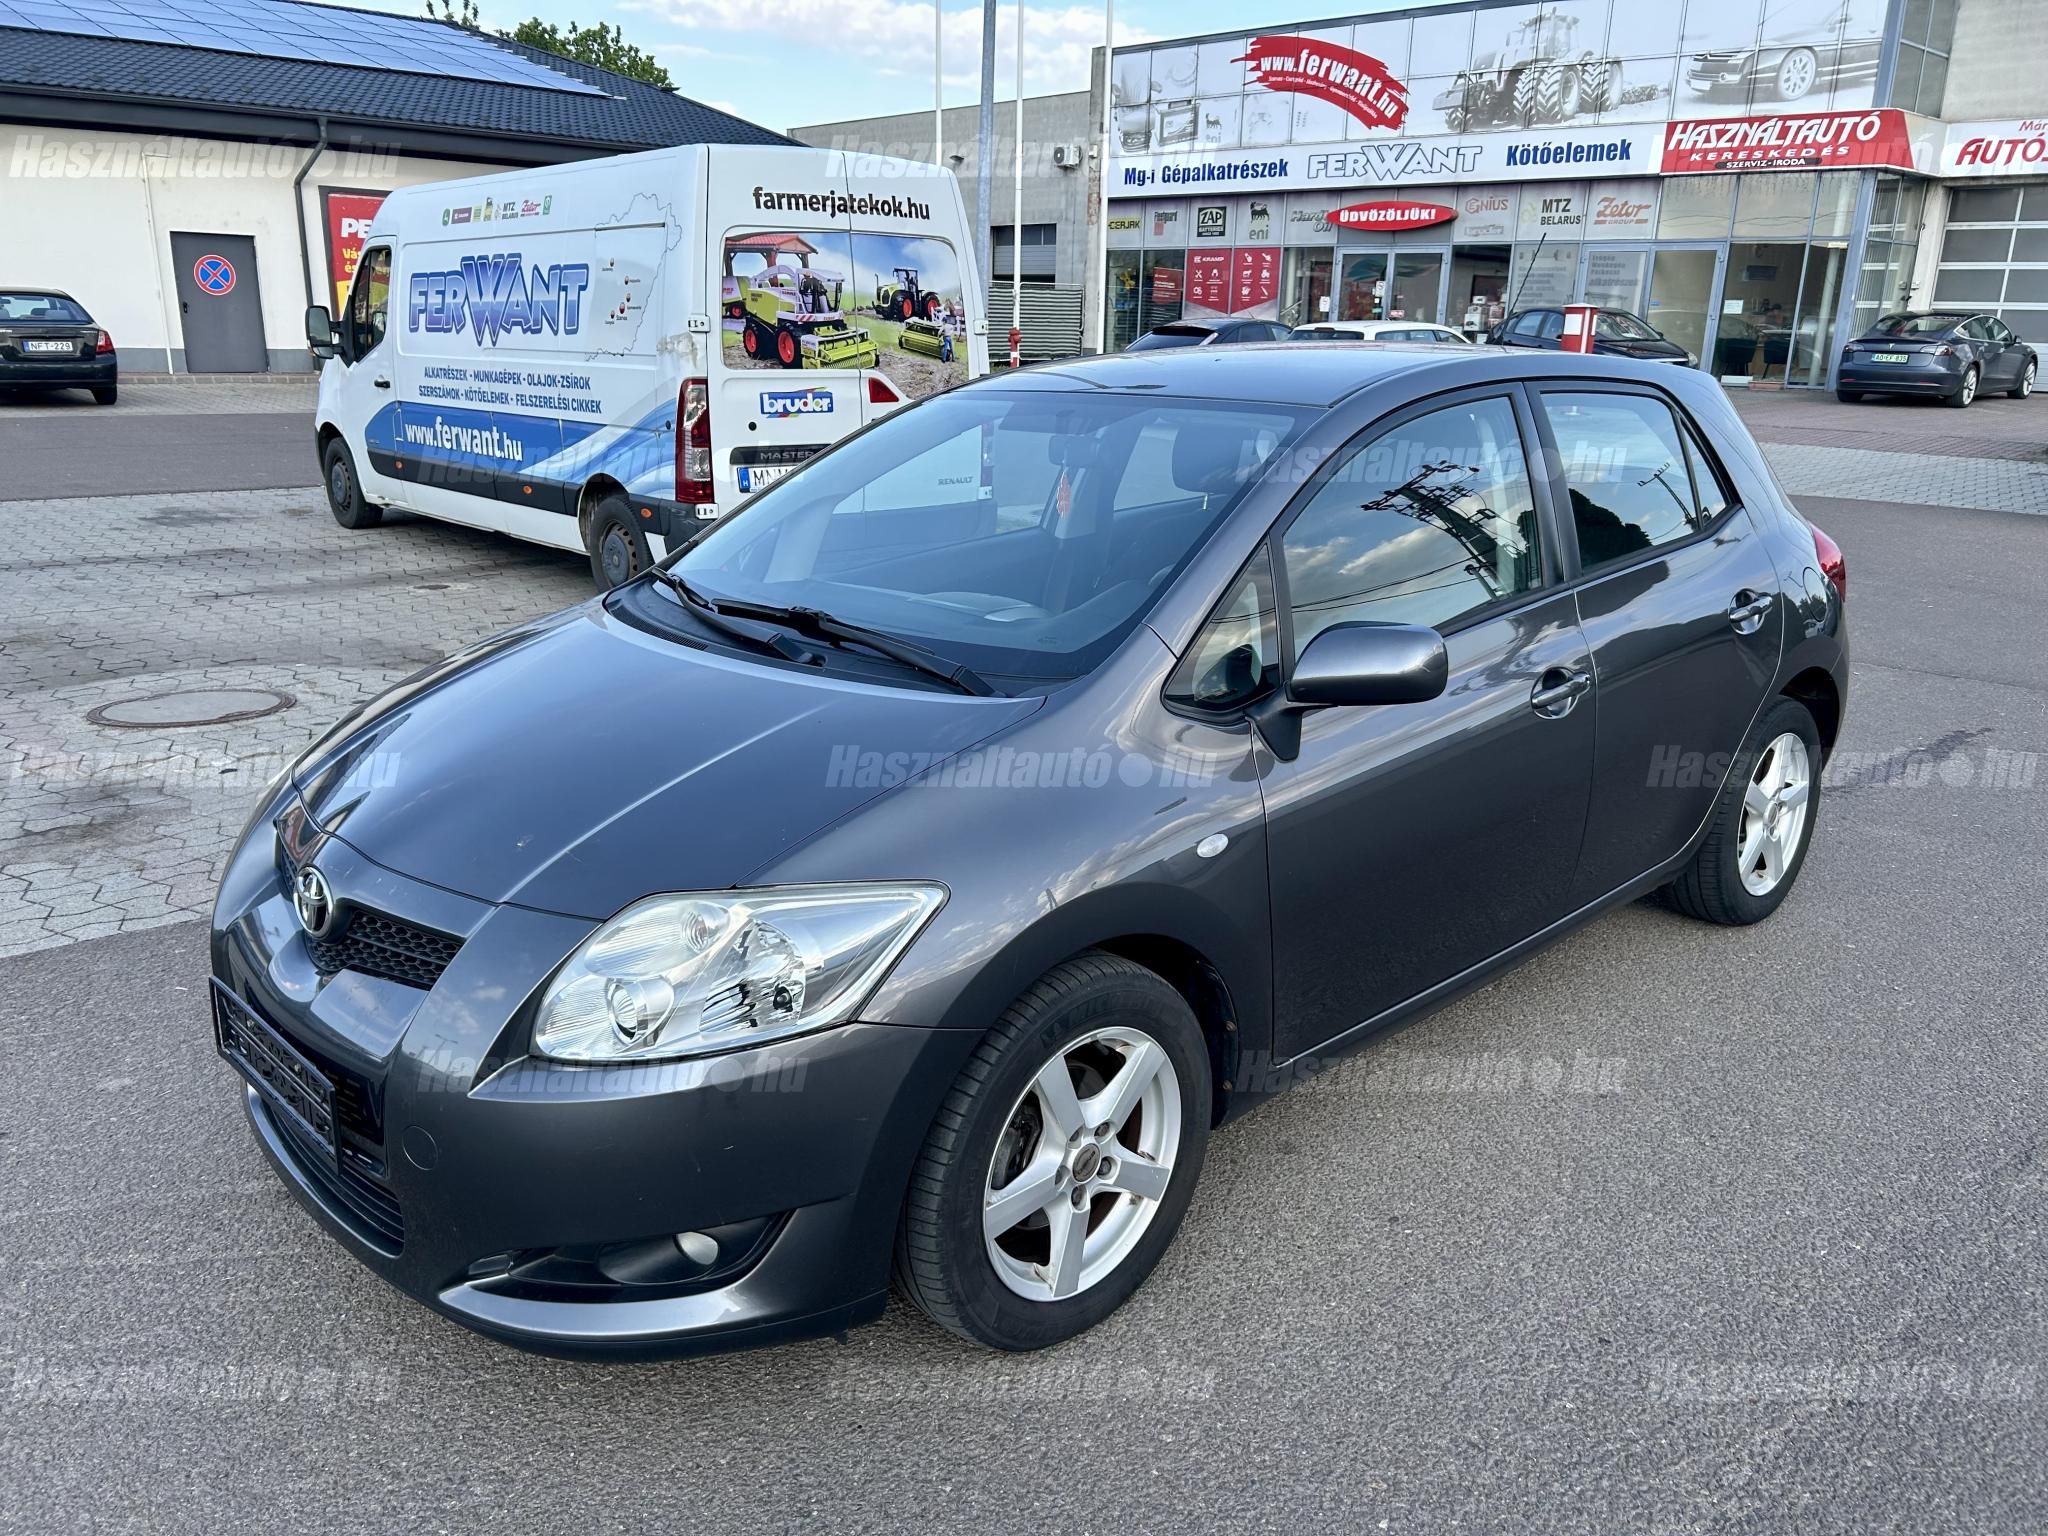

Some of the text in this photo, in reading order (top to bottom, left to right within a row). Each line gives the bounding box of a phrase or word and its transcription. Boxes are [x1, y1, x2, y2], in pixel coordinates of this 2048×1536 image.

[1260, 49, 1399, 119] www.ferwant.hu
[1667, 111, 1881, 150] HASZNÁLTAUTÓ
[1505, 139, 1632, 167] Kötőelemek
[1690, 146, 1850, 162] KERESKEDÉS
[1955, 132, 2048, 166] AUTÓ
[1124, 158, 1289, 186] Mg-i Gépalkatrészek
[1307, 143, 1483, 181] FERWANT
[752, 186, 931, 221] farmerjatekok.hu
[1339, 208, 1436, 223] ÜDVÖZÖLJÜK!
[1541, 198, 1571, 213] MTZ
[1597, 197, 1652, 218] Zetor
[1200, 211, 1223, 224] ZAP
[1540, 214, 1581, 226] BELARUS
[1249, 225, 1269, 240] eni
[409, 253, 589, 347] FERWANT
[424, 365, 467, 380] ALKATRÉSZEK
[473, 369, 522, 385] MUNKAGÉPEK
[418, 384, 461, 400] SZERSZÁMOK
[515, 393, 571, 412] FELSZERELÉSI
[571, 400, 602, 414] CIKKEK
[762, 393, 830, 414] bruder
[404, 416, 523, 462] www.ferwant.hu
[938, 476, 973, 486] RENAULT
